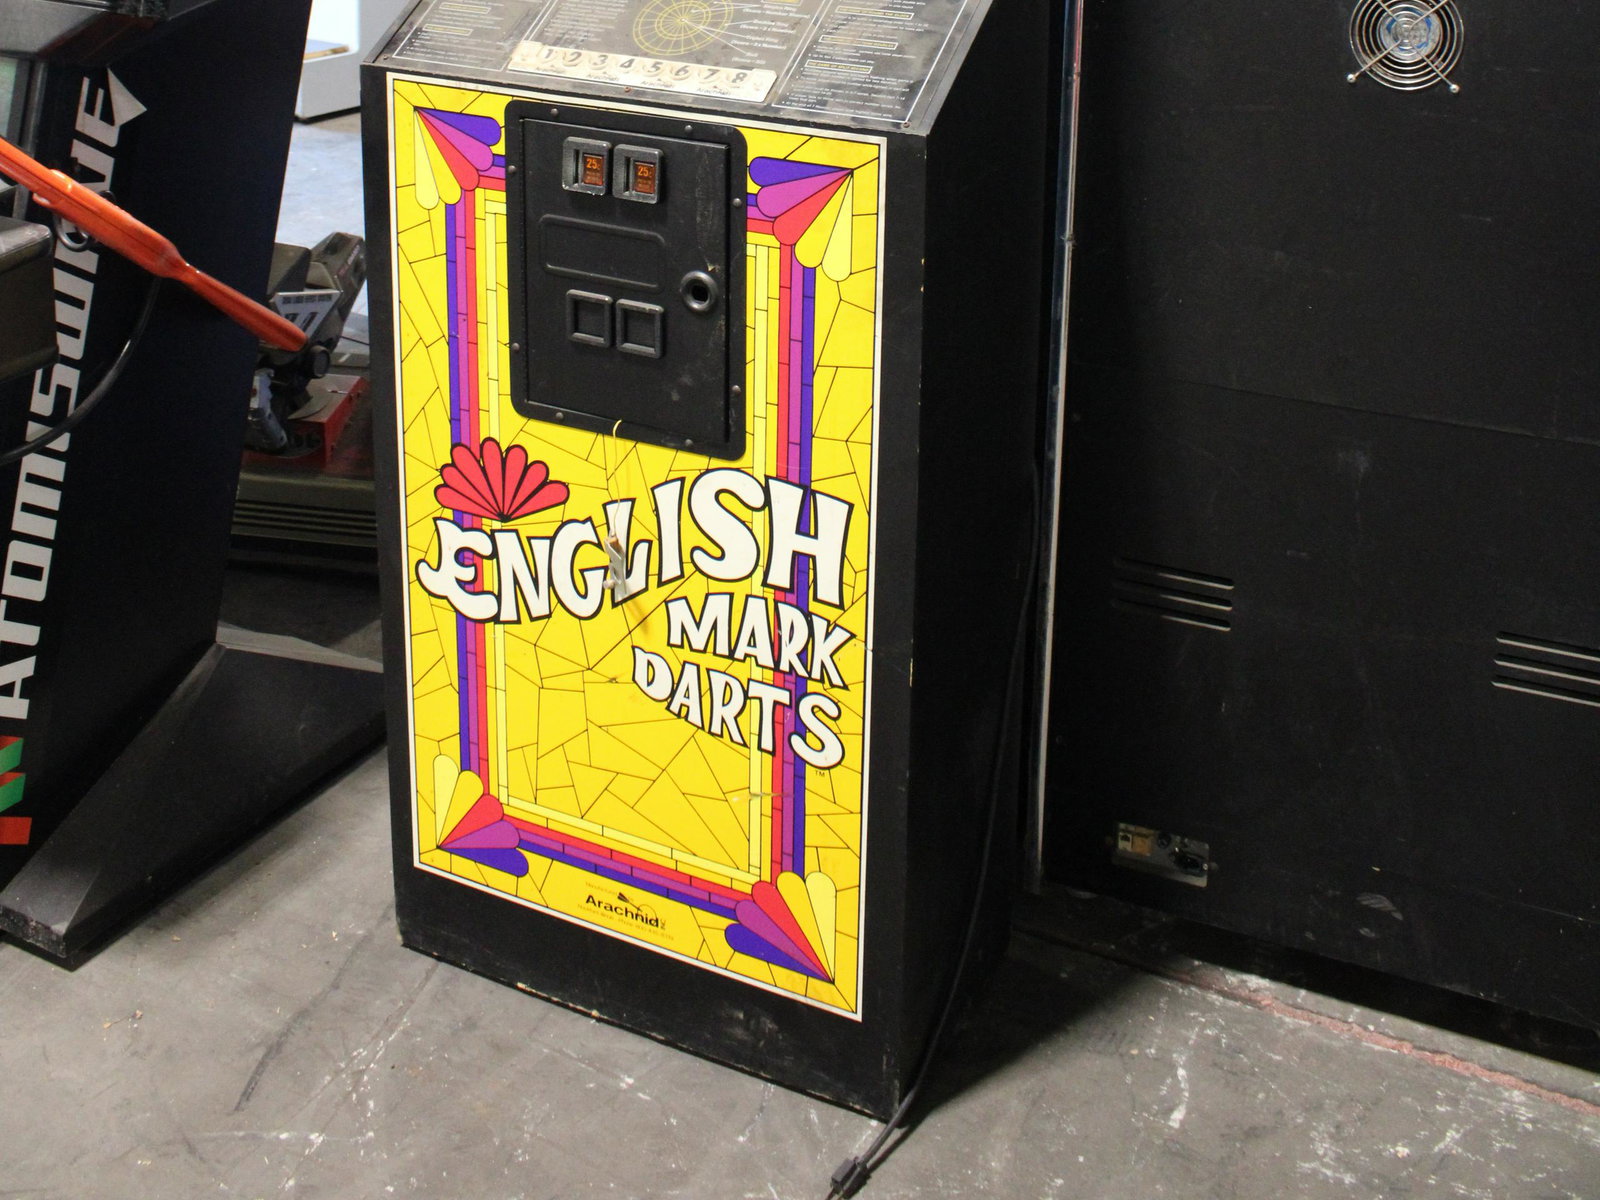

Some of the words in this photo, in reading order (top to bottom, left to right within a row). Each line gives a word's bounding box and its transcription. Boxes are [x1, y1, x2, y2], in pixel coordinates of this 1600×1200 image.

[544, 49, 554, 59] 1
[567, 51, 582, 62] 2
[593, 54, 608, 66] 3
[619, 58, 635, 69] 4
[647, 61, 663, 73] 5
[674, 65, 689, 76] 6
[703, 68, 721, 80] 7
[731, 72, 748, 83] 8
[415, 468, 855, 624] ENGLISH
[666, 593, 855, 690] MARK
[633, 646, 844, 769] DARTS
[585, 894, 660, 929] Arachnid
